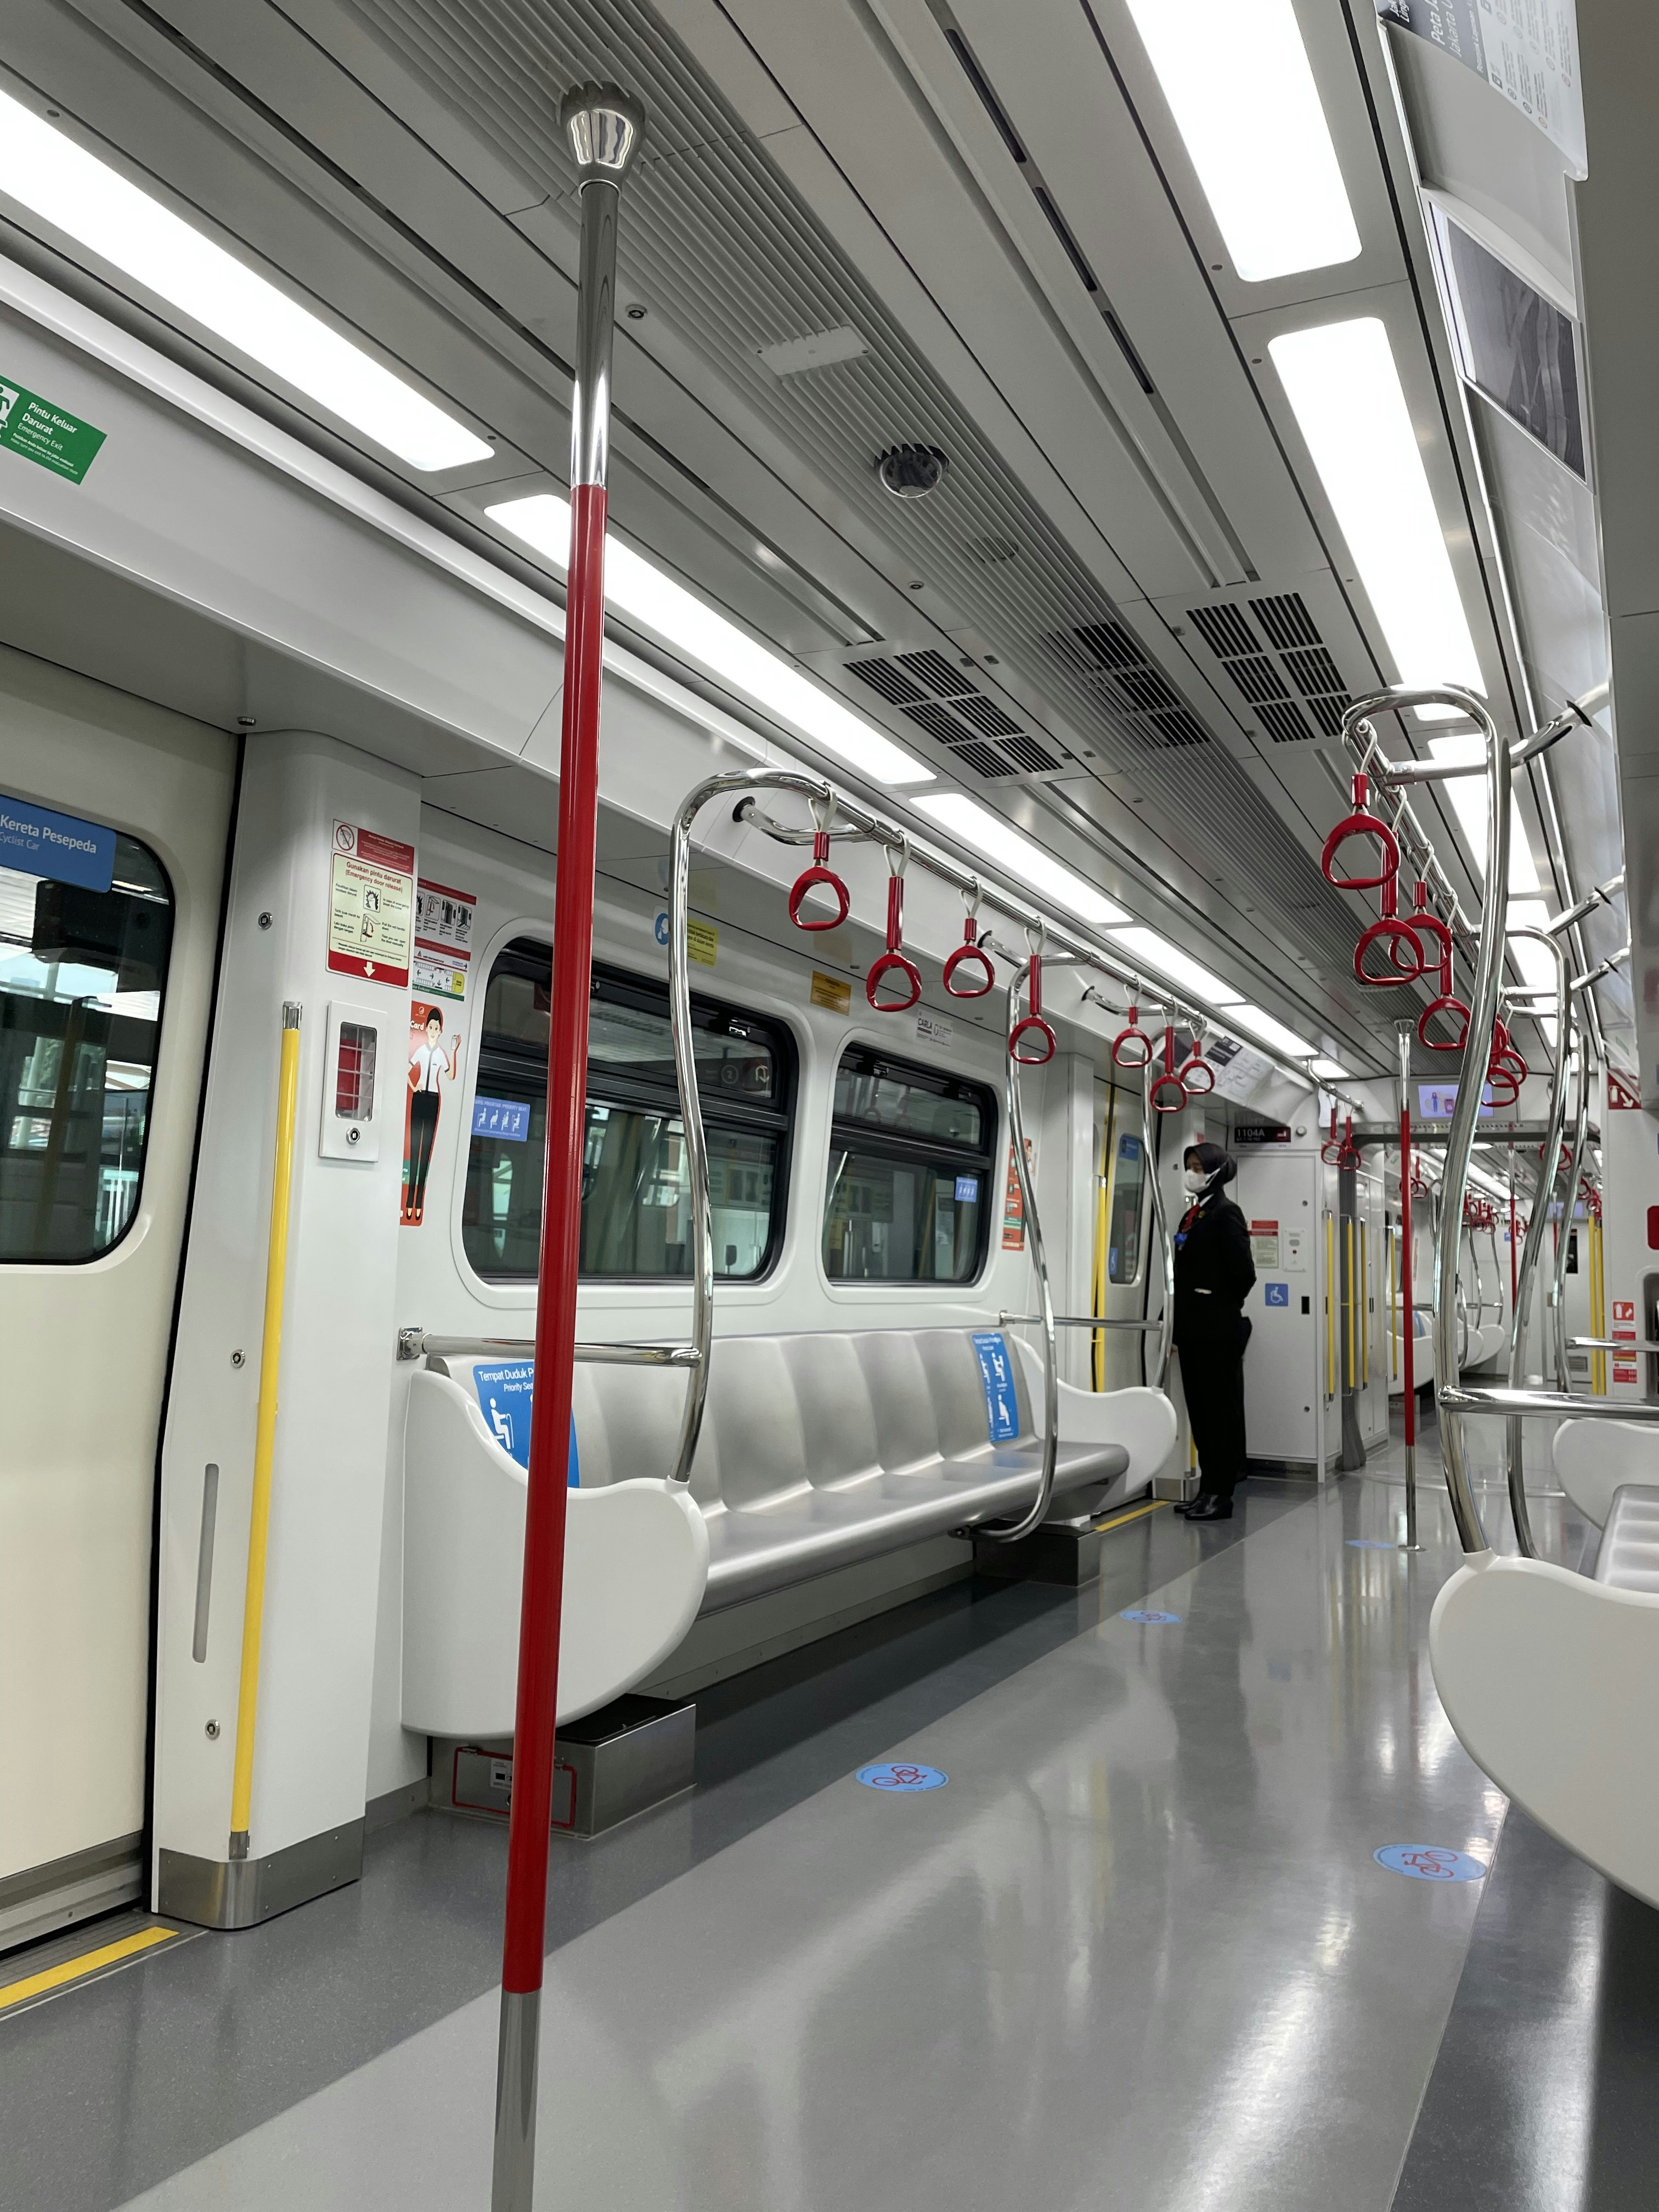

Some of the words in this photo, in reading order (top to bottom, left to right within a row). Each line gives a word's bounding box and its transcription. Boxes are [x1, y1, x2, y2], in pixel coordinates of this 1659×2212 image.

[1430, 11, 1446, 45] Peta
[1445, 12, 1462, 57] Jakarta
[21, 413, 53, 435] Darurat
[28, 402, 50, 419] Pintu
[51, 415, 77, 433] Keluar
[17, 422, 50, 445] Emergency
[50, 440, 64, 451] Exit
[0, 814, 40, 837] Kereta
[42, 827, 97, 854] Pesepeda
[0, 832, 24, 847] Cyclist
[26, 839, 40, 851] Car
[346, 869, 373, 883] (Emergency
[385, 882, 403, 893] release)
[347, 861, 369, 874] Gunakan
[370, 870, 383, 879] pintu
[384, 874, 402, 884] darurat
[410, 1020, 425, 1030] Card
[1237, 1128, 1265, 1137] 1104A
[478, 1370, 505, 1383] Tempat
[505, 1368, 528, 1379] Duduk
[504, 1383, 522, 1393] Priority
